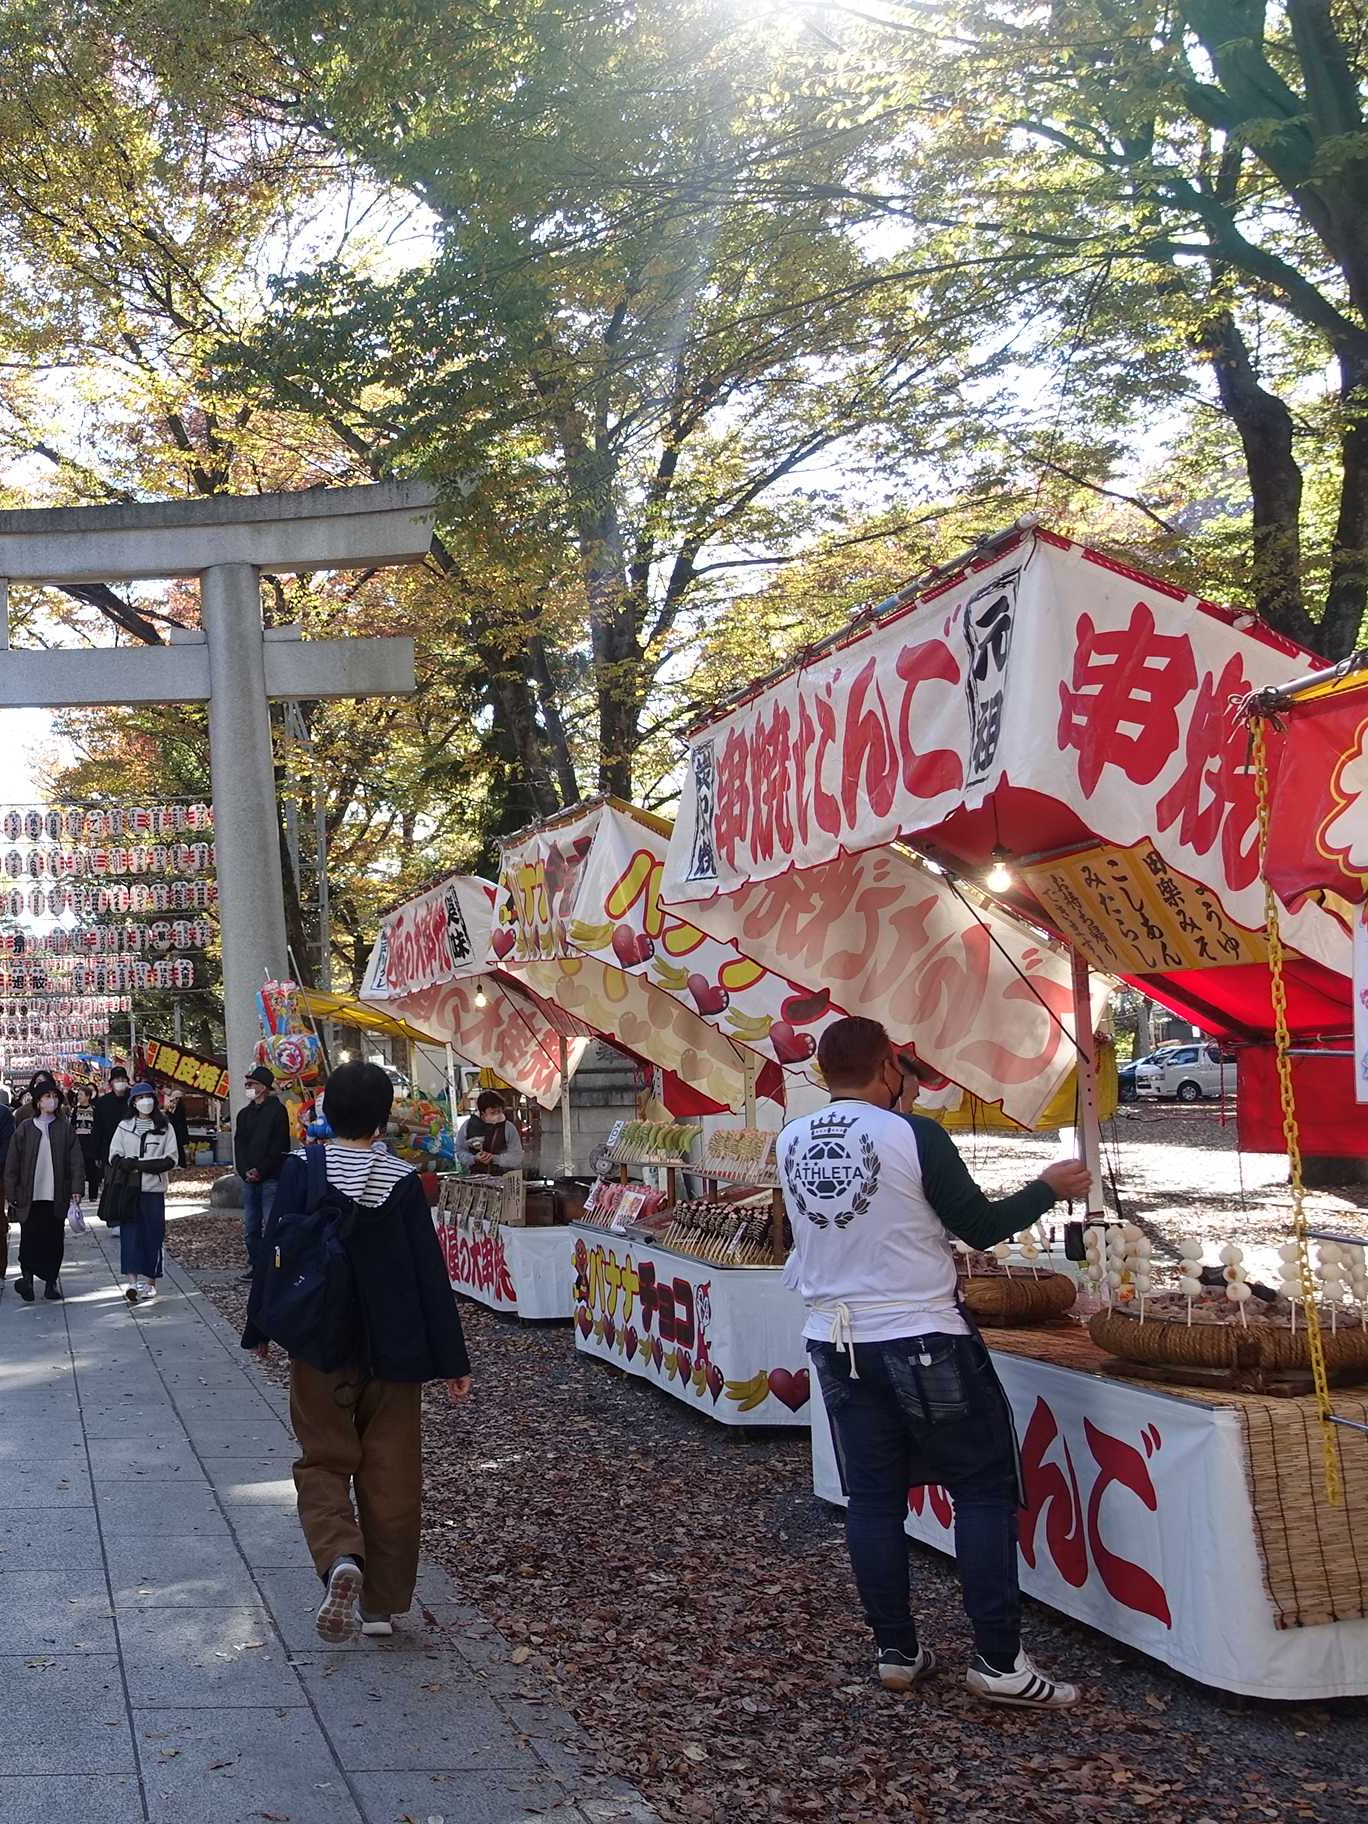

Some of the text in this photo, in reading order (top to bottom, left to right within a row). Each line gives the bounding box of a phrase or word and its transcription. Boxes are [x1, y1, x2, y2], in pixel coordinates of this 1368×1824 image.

[714, 603, 964, 873] 串焼だんご
[972, 595, 1011, 773] 元祖
[1080, 865, 1156, 969] みたらし
[1106, 858, 1182, 967] こしあん
[793, 1166, 865, 1180] ATHLETA
[589, 1243, 696, 1350] バナナチョコ
